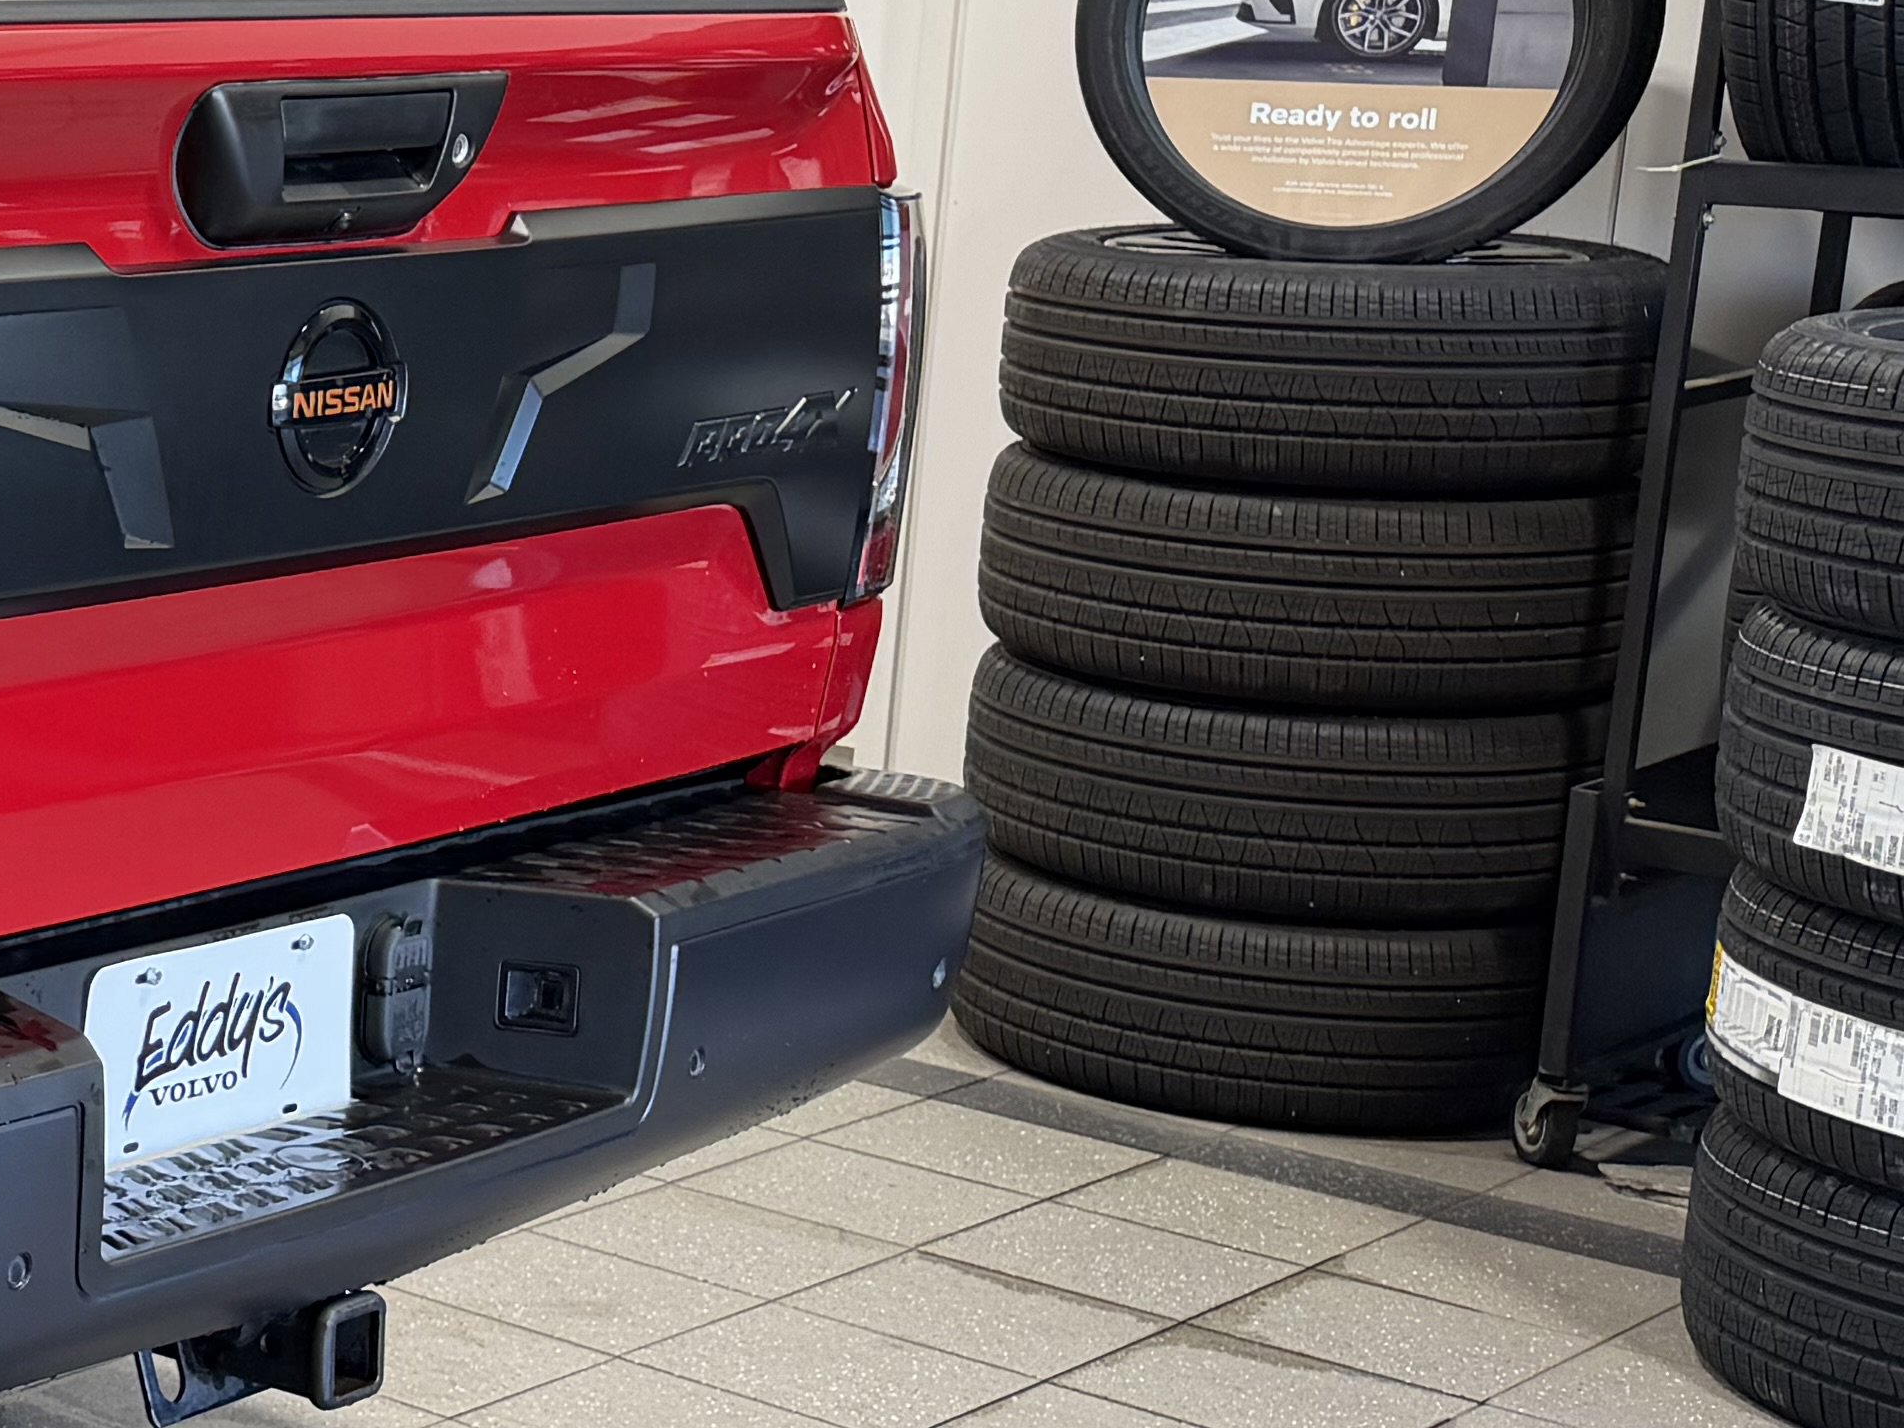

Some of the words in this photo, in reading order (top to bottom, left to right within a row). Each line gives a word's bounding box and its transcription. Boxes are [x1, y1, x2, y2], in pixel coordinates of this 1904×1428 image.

[1249, 102, 1342, 132] Ready
[1349, 106, 1380, 129] to
[1388, 108, 1438, 131] roll
[1344, 138, 1391, 150] Advantage
[292, 378, 394, 420] NISSAN
[134, 972, 292, 1093] Eddy's
[149, 1070, 238, 1106] VOLVO
